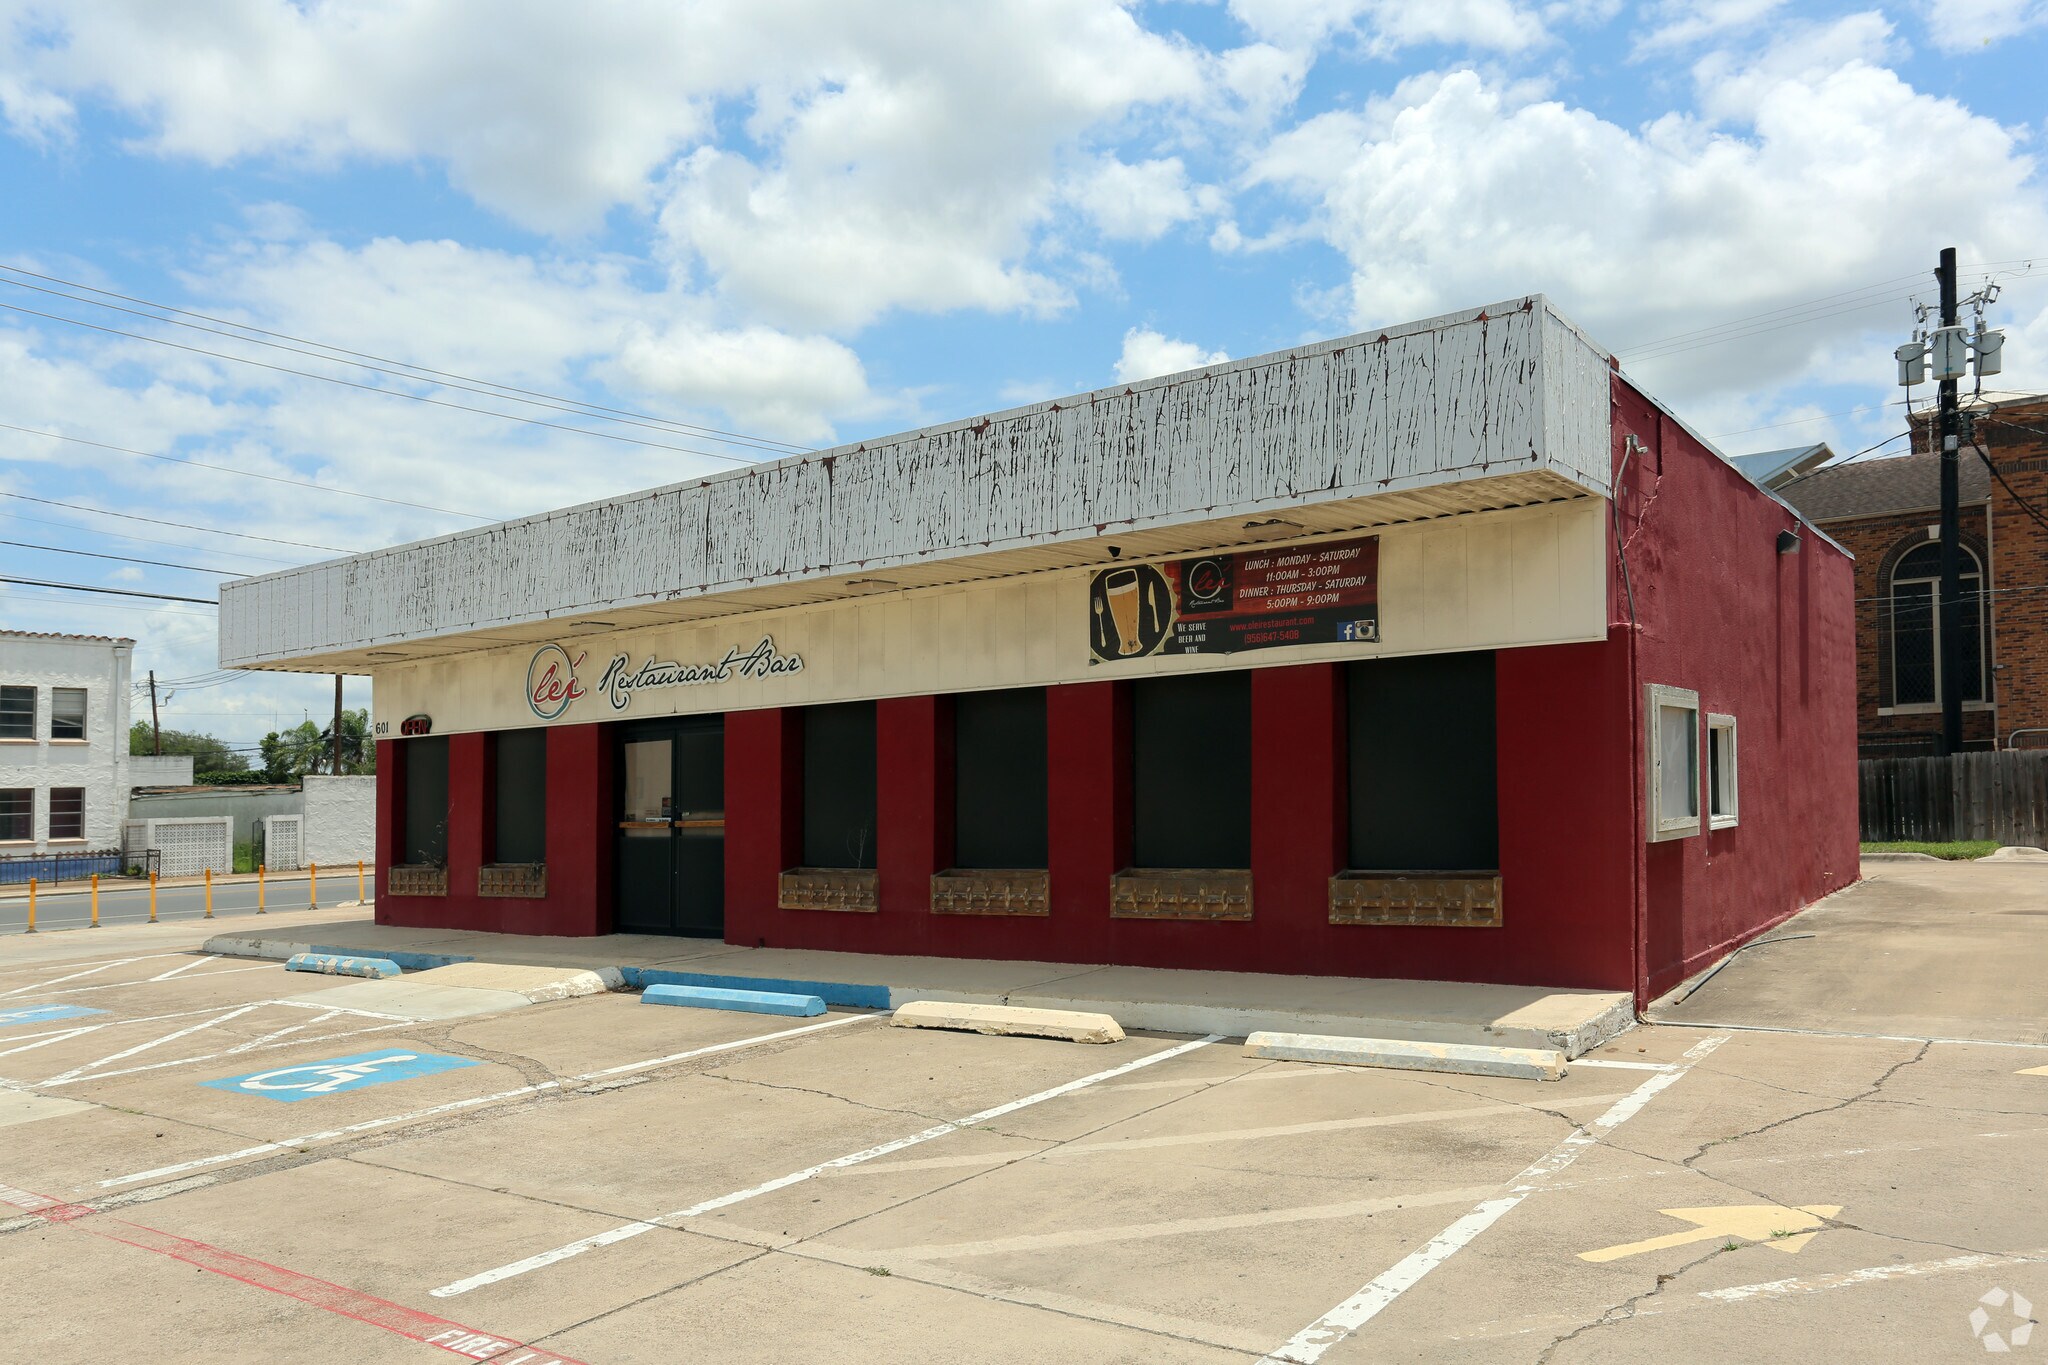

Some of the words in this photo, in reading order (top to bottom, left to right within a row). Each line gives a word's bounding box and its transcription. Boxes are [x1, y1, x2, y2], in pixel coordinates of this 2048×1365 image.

[1245, 559, 1270, 571] LUNCH
[1277, 554, 1311, 568] MONDAY
[1319, 548, 1361, 562] SATURDAY
[1266, 569, 1299, 582] 11:00AM
[1308, 565, 1340, 578] 3:00PM
[1239, 587, 1269, 598] DINNER
[1277, 581, 1316, 594] THURSDAY
[1325, 576, 1366, 590] SATURDAY
[1266, 597, 1298, 609] 5:00PM
[1307, 593, 1340, 605] 9:00PM
[1188, 623, 1206, 632] SERVE
[1230, 616, 1315, 631] www.oleirestaurant.com
[1178, 635, 1193, 644] BEER
[1194, 634, 1206, 642] AND
[1244, 630, 1300, 645] (956)647-5408
[1184, 645, 1199, 654] WINE
[598, 648, 735, 711] Restaurant
[739, 636, 802, 677] Bar
[375, 721, 389, 734] 601
[401, 719, 429, 736] OPEN
[425, 1329, 508, 1358] FIRE
